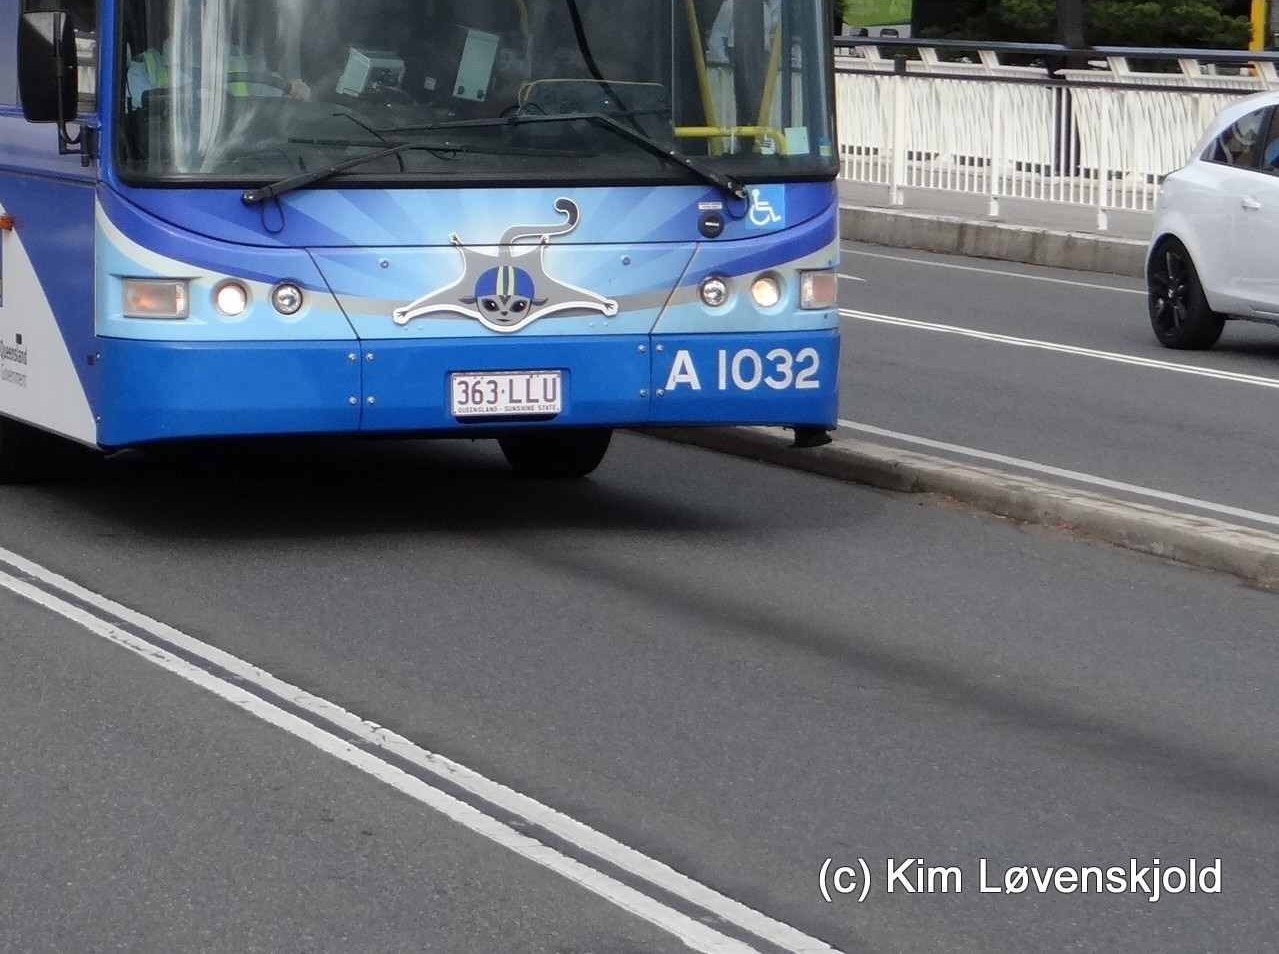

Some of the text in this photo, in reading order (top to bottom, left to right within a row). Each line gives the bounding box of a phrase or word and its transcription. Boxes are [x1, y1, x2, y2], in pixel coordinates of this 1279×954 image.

[0, 340, 27, 365] Queensland
[665, 347, 820, 390] A 1032
